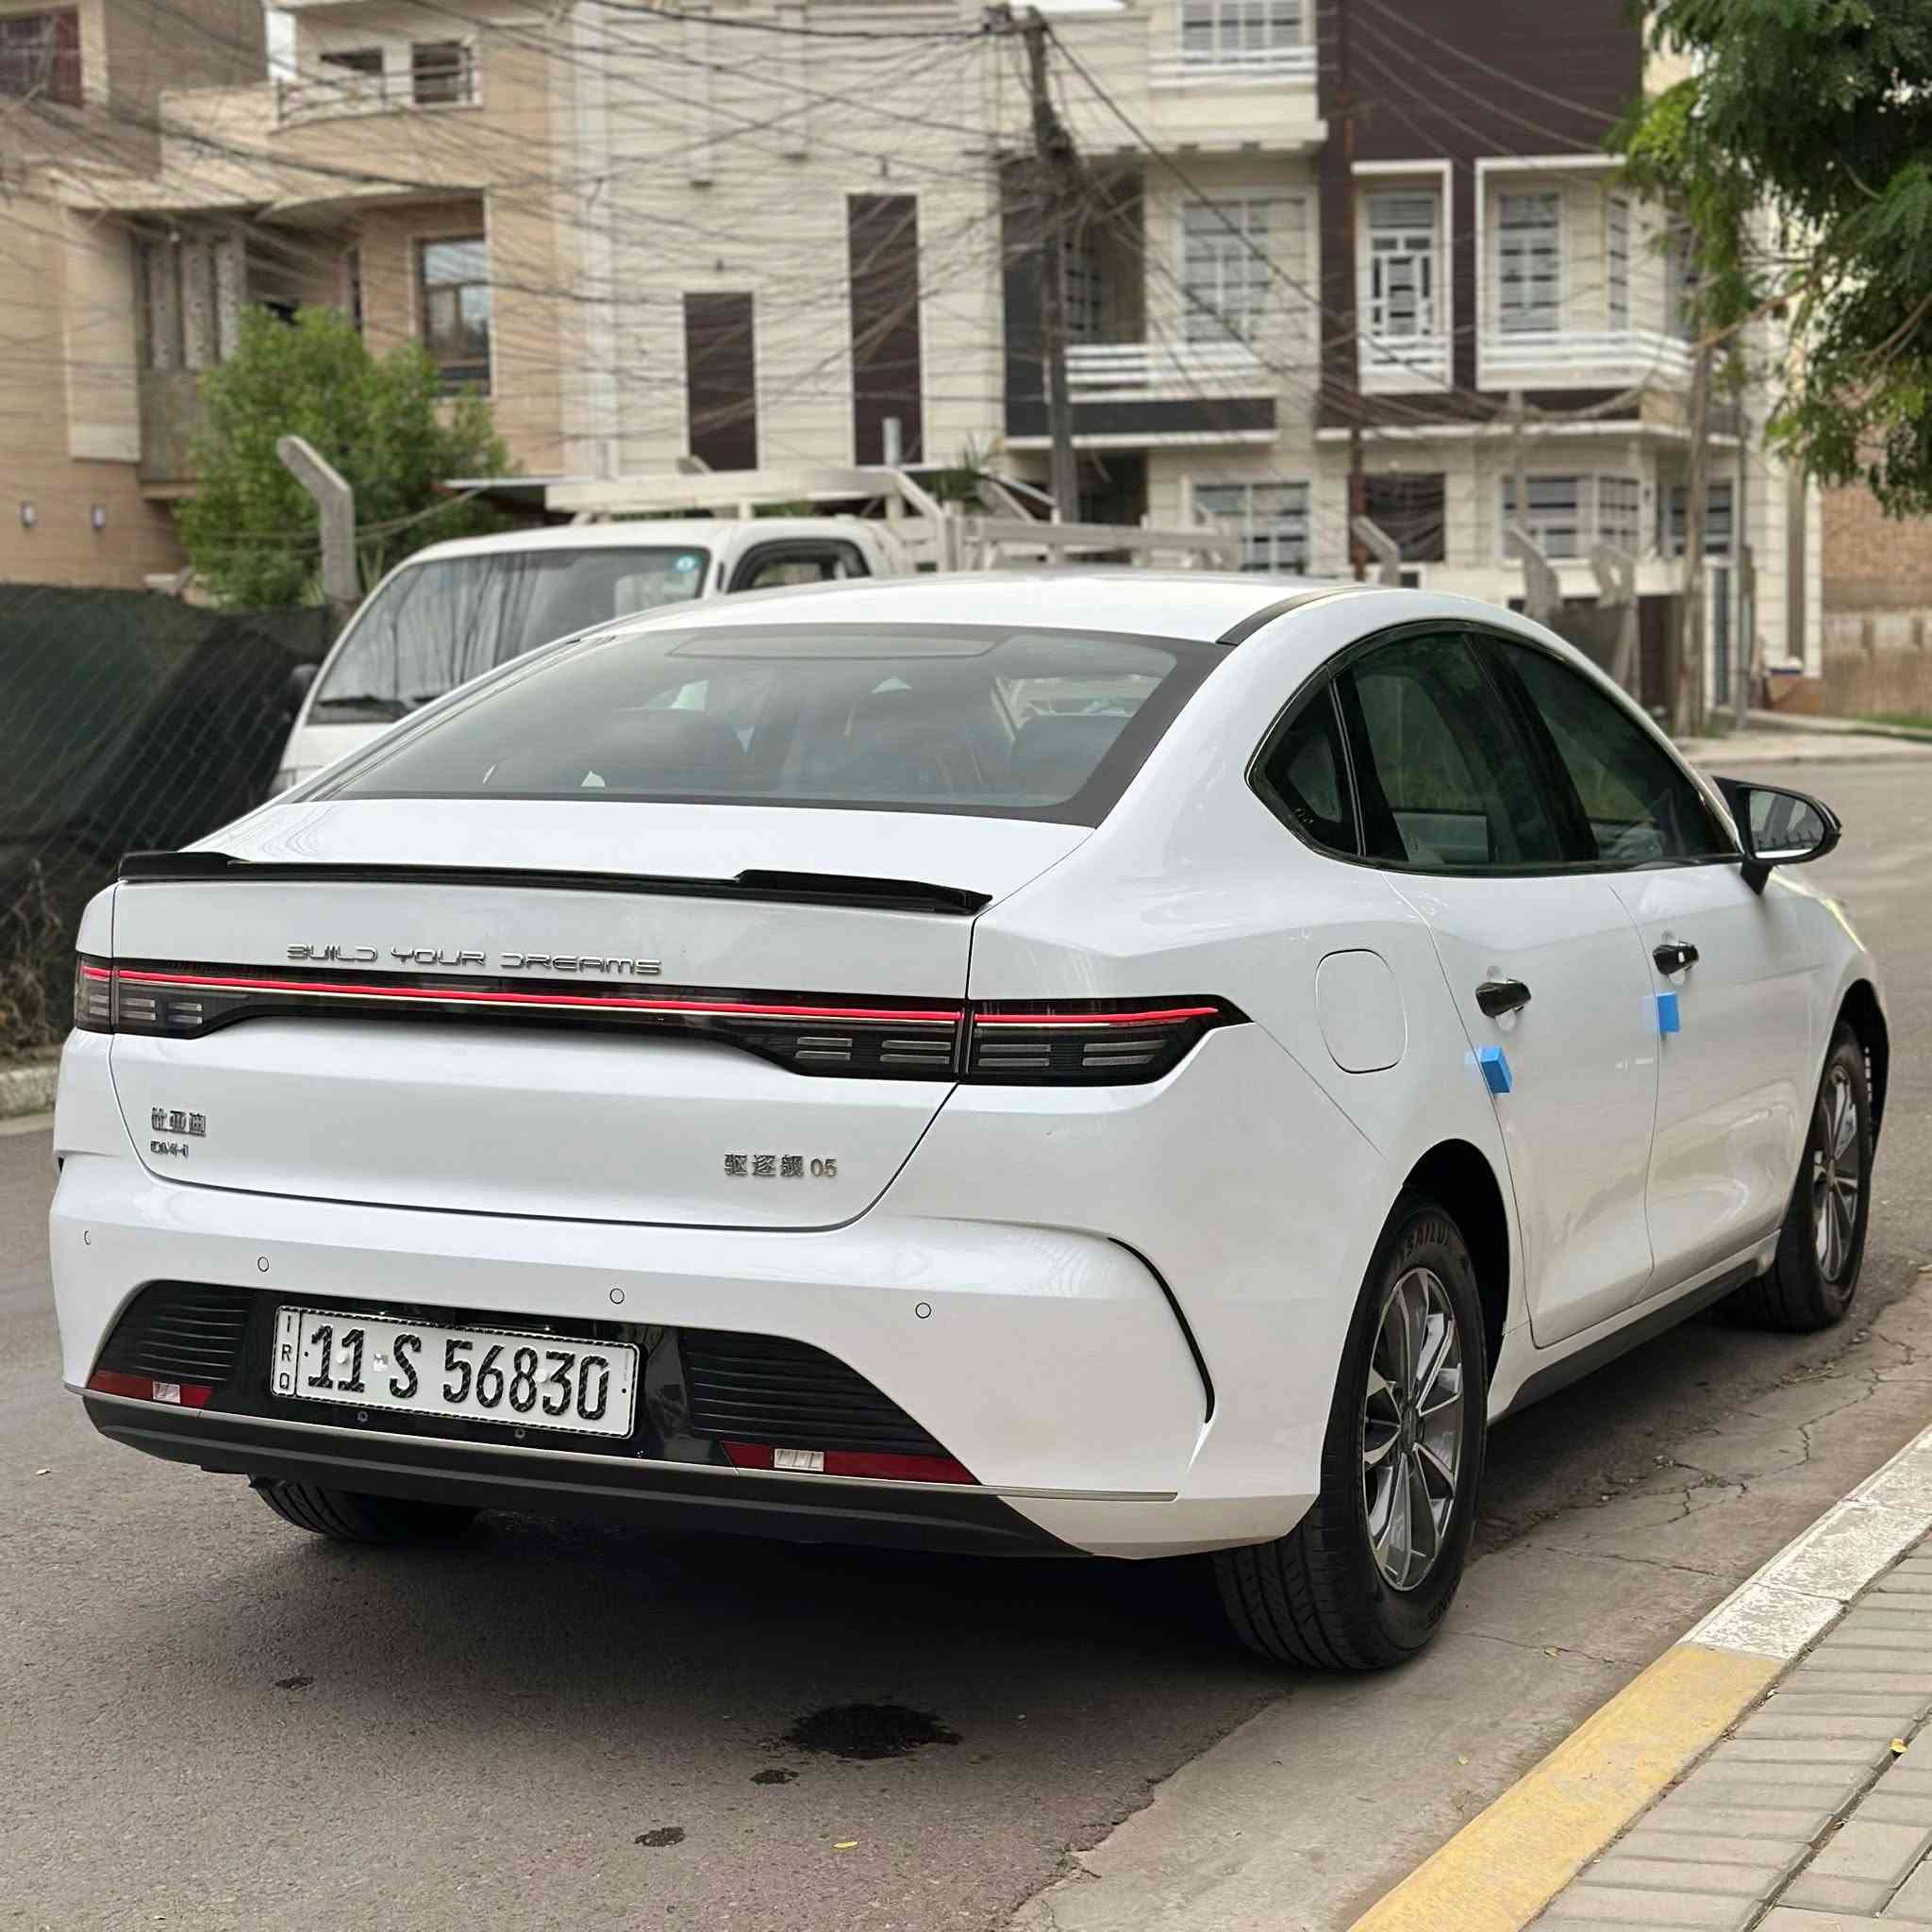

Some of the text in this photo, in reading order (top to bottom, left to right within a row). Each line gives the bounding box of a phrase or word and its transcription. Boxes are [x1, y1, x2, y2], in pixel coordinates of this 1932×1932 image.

[286, 942, 662, 975] BUILD YOUR DREAMS
[809, 1158, 838, 1177] 05
[308, 1324, 610, 1421] 11 S 56830
